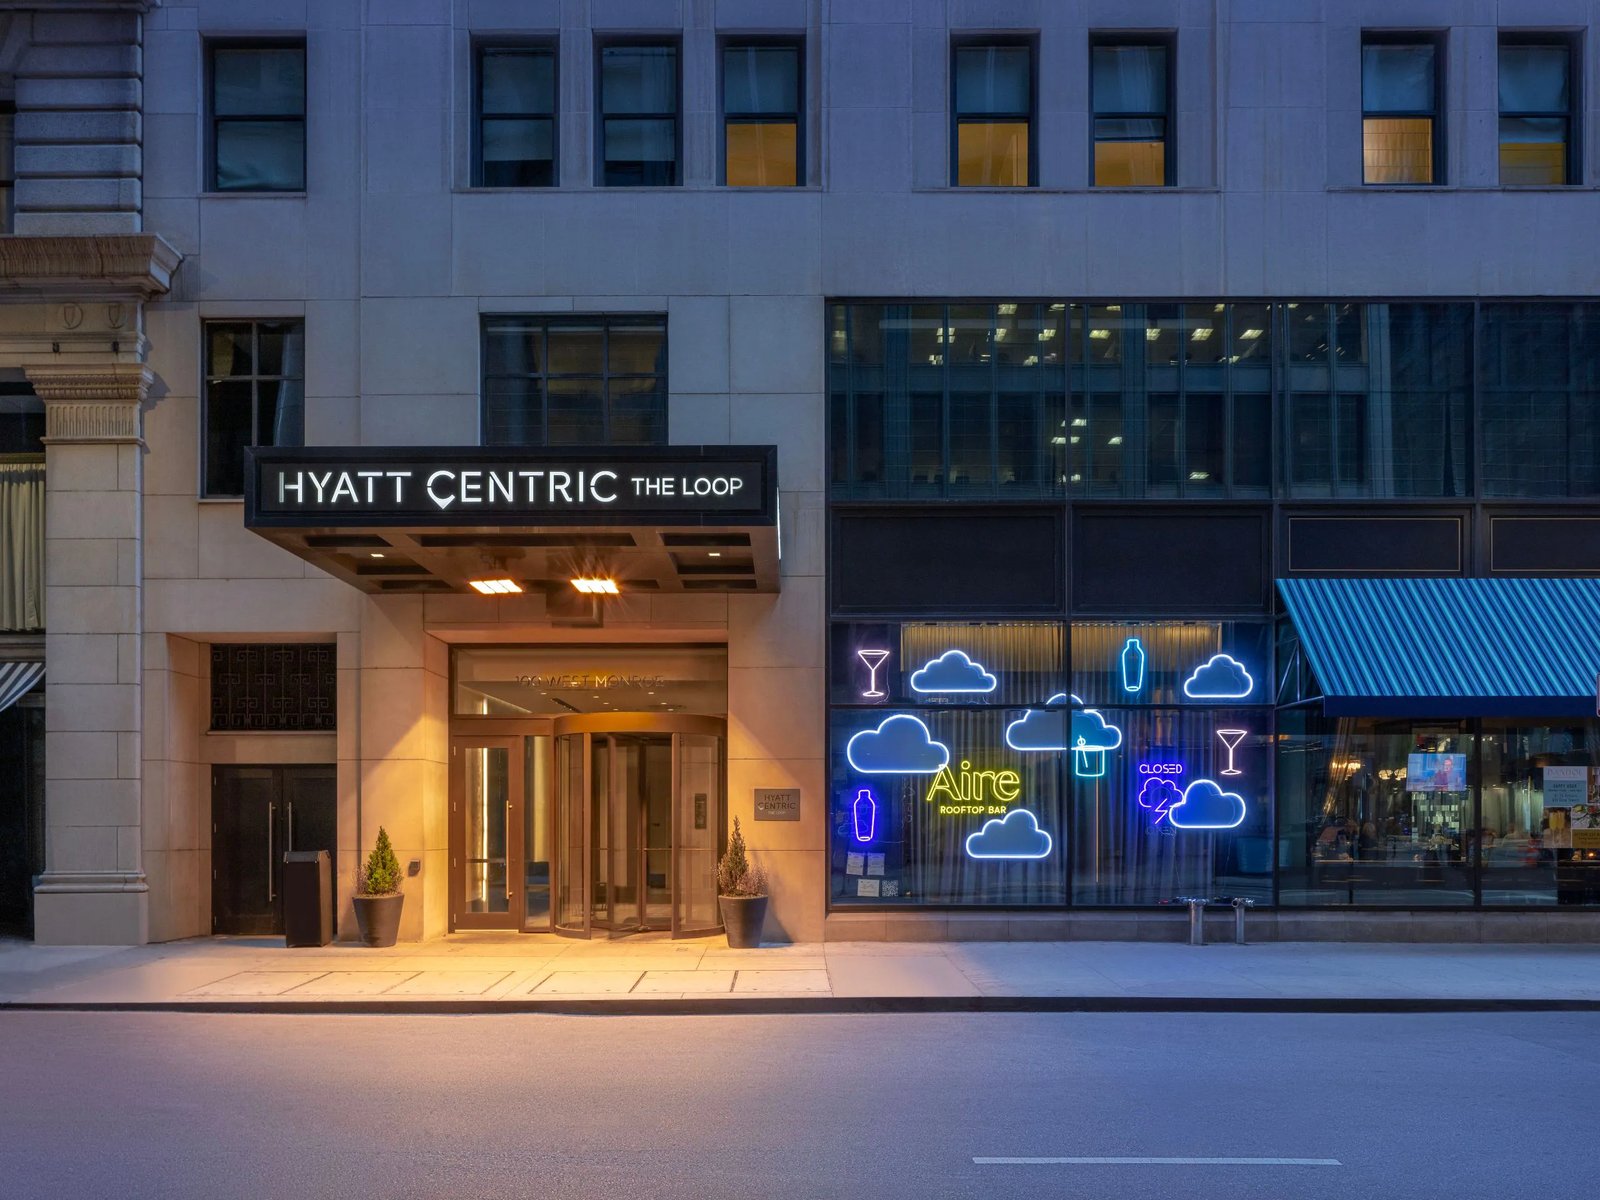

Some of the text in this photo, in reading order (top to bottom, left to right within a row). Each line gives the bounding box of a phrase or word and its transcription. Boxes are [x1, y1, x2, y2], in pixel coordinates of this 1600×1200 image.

[278, 470, 744, 509] HYATT CENTRIC THE LOOP
[546, 675, 590, 688] WEST
[595, 675, 665, 688] MONROE
[1139, 763, 1183, 774] CLOSED
[926, 760, 1020, 801] Aire
[757, 802, 796, 810] CENTRIC
[940, 805, 1007, 815] ROOFTOP BAR
